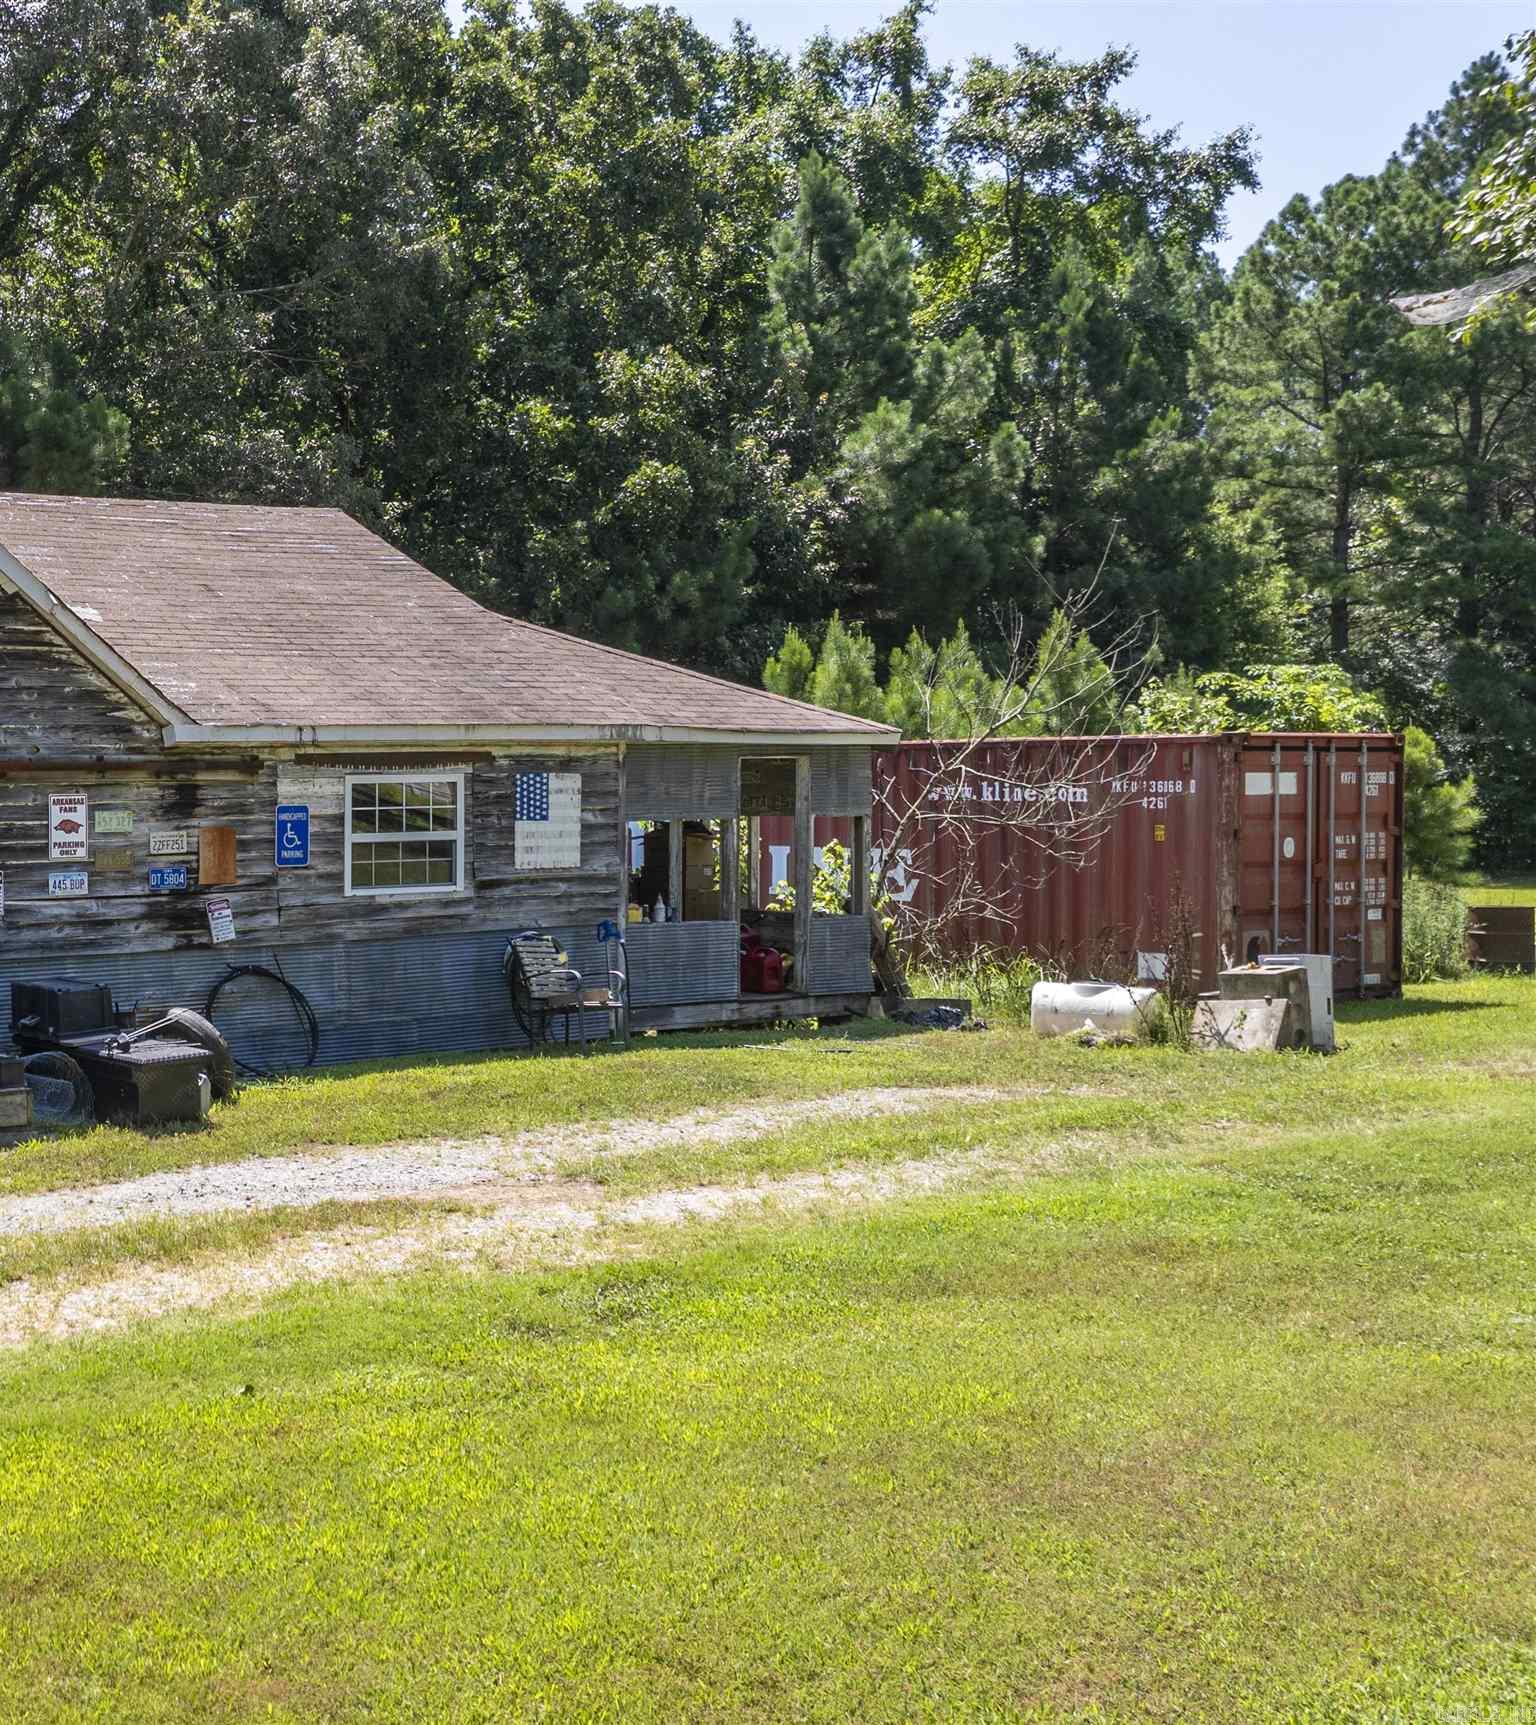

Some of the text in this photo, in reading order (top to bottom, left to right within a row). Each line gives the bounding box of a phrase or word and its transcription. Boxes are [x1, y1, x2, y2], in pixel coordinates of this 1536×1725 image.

[52, 797, 85, 806] ARKANSAS
[59, 806, 78, 814] FANS
[53, 841, 85, 849] PARKING
[59, 849, 78, 857] ONLY
